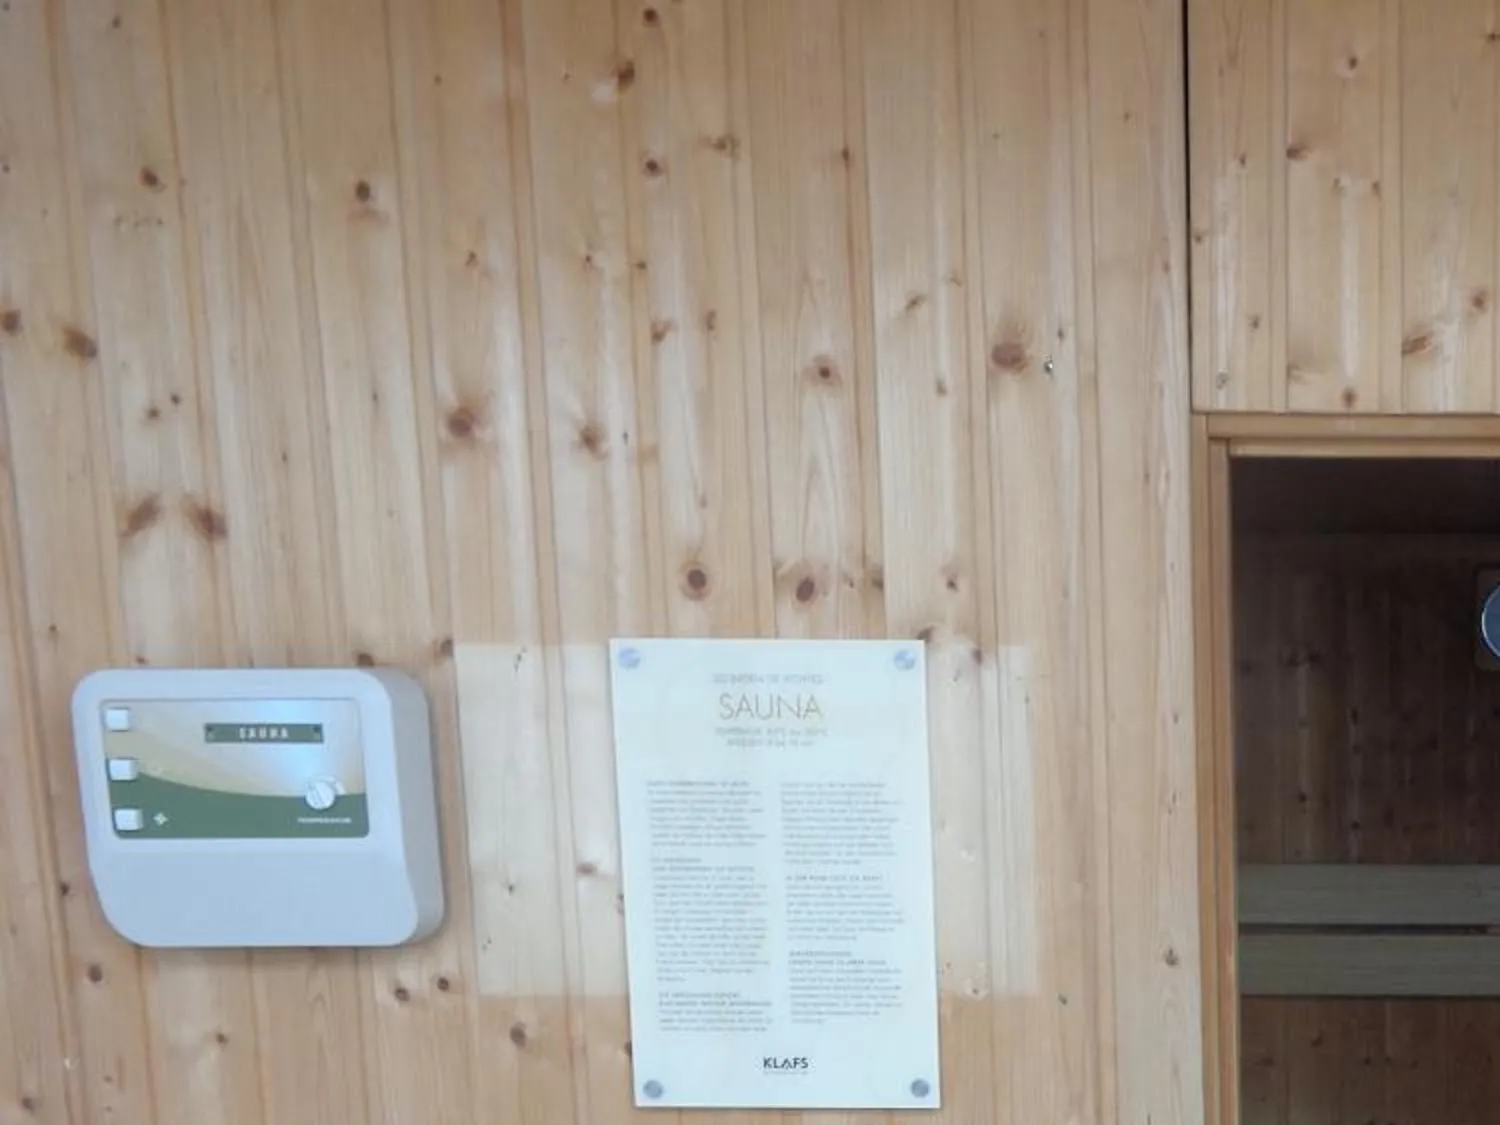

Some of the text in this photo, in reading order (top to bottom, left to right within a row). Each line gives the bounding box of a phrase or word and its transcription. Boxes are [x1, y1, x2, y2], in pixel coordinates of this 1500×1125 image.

[719, 692, 823, 721] SAUNA
[238, 727, 289, 739] SAUNA
[763, 1057, 809, 1069] KLAFS
